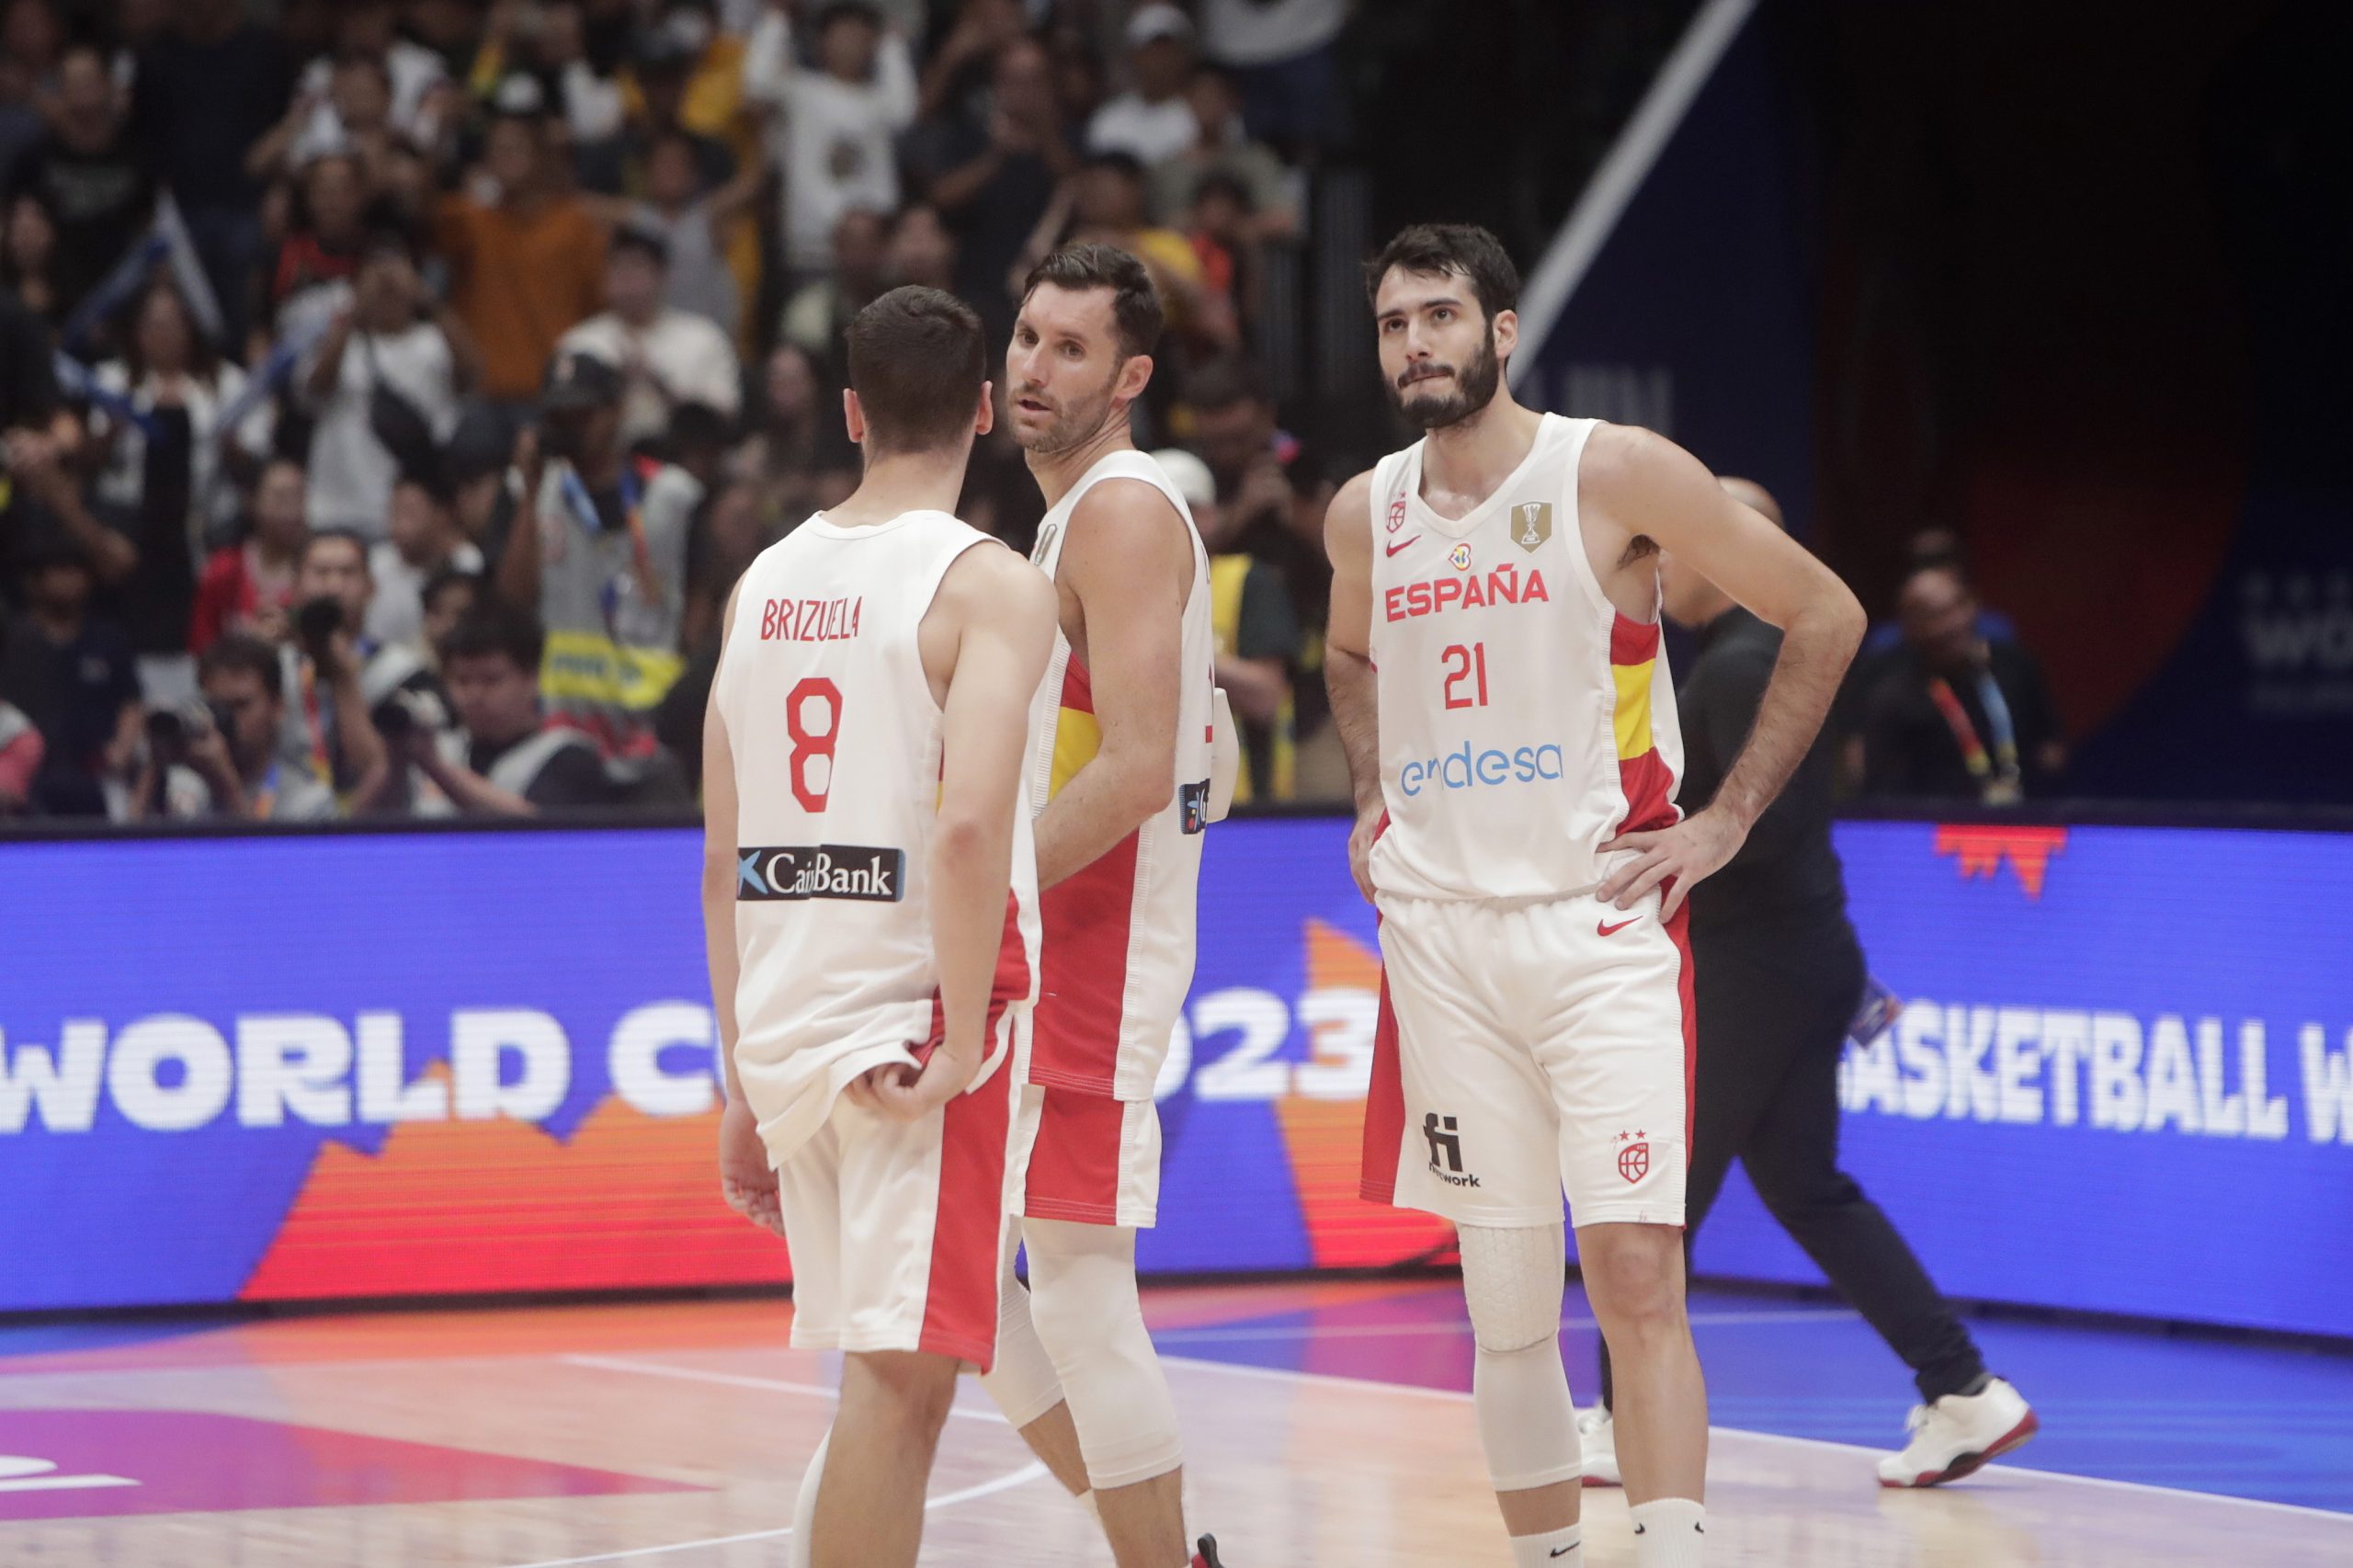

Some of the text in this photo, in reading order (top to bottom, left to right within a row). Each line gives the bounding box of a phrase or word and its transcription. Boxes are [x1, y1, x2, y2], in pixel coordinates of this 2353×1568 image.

[760, 596, 862, 642] BRIZUELA
[1385, 562, 1550, 623] ESPAÑA
[1440, 642, 1489, 710] 21
[785, 676, 844, 813] 8
[1401, 740, 1563, 797] endesa
[0, 1007, 573, 1134] WORLD
[1154, 985, 1380, 1102] 23
[1836, 998, 2289, 1142] ASKETBALL
